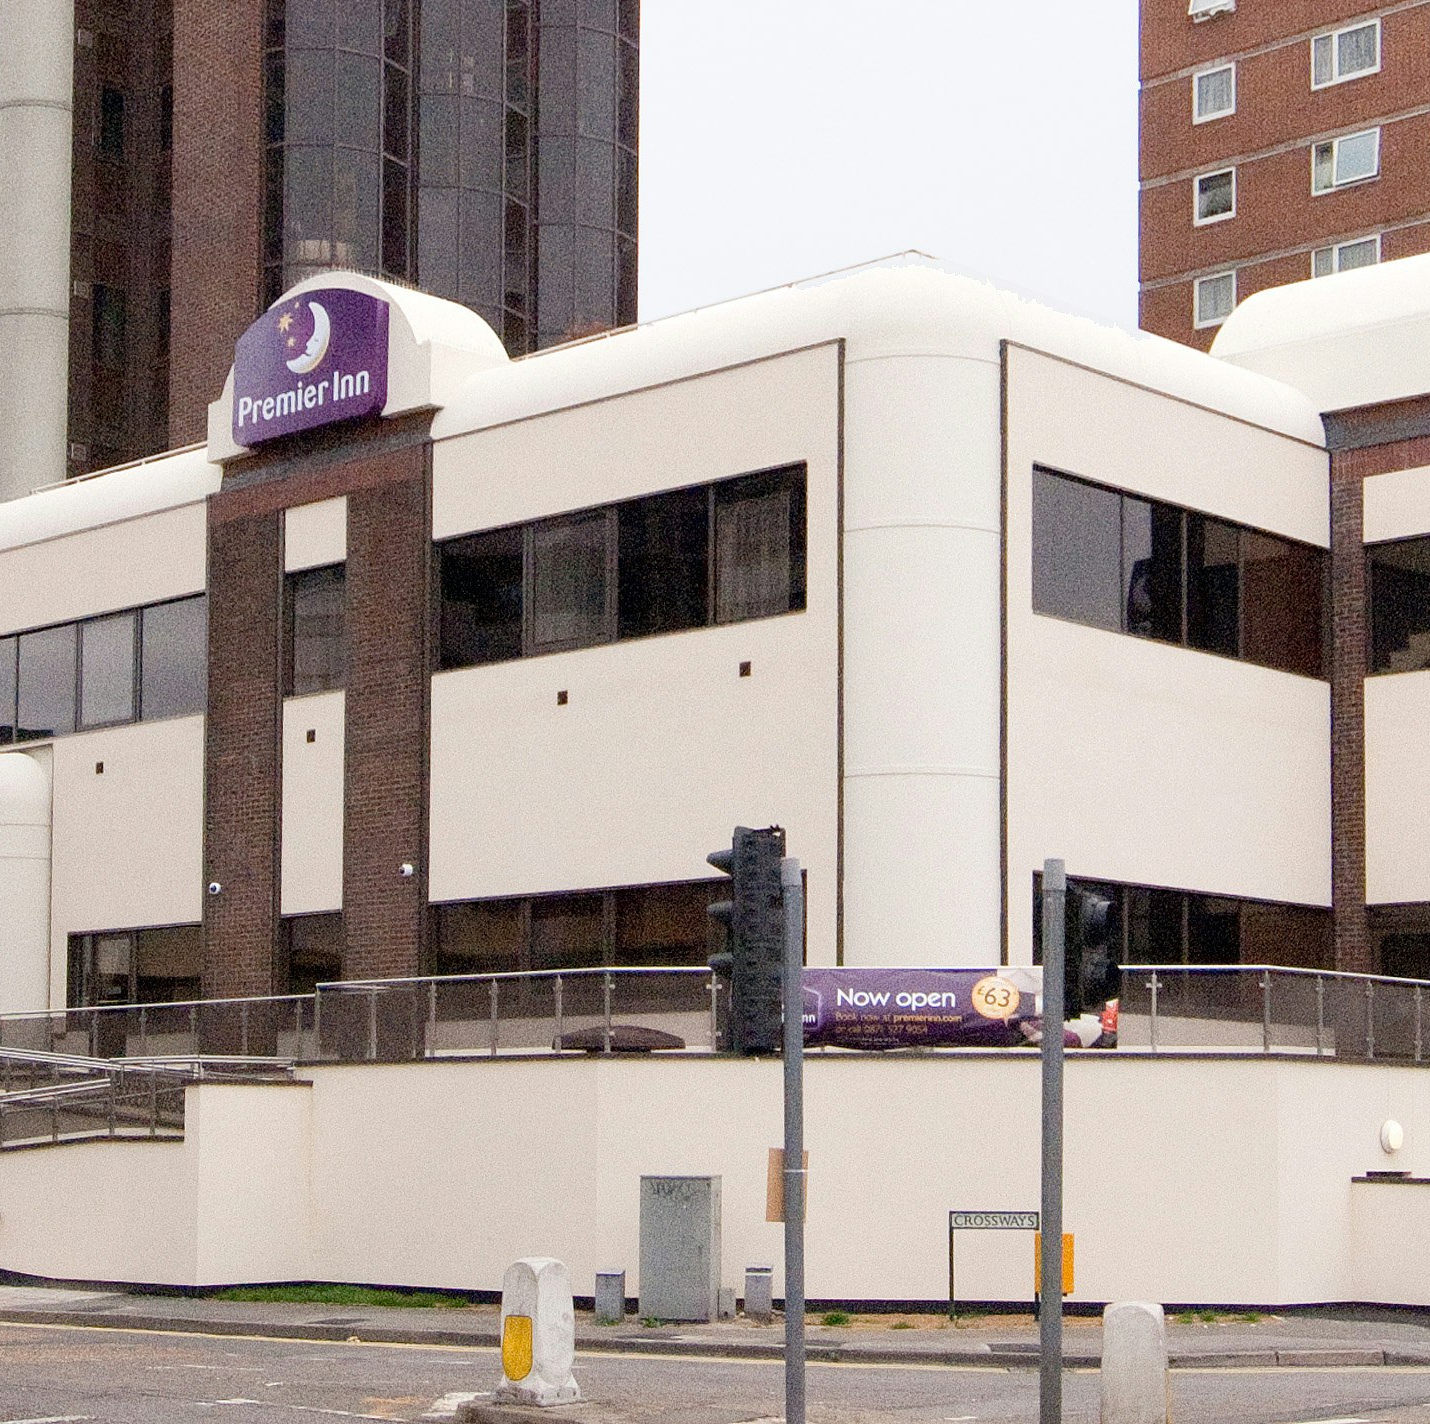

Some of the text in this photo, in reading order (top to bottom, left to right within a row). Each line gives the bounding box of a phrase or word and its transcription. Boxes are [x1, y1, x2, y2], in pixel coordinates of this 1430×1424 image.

[238, 370, 370, 427] Premier Inn
[837, 988, 956, 1010] Now open
[802, 1014, 816, 1023] nn
[893, 1014, 962, 1023] premierinn.com
[954, 1214, 1034, 1226] CROSSWAYS
